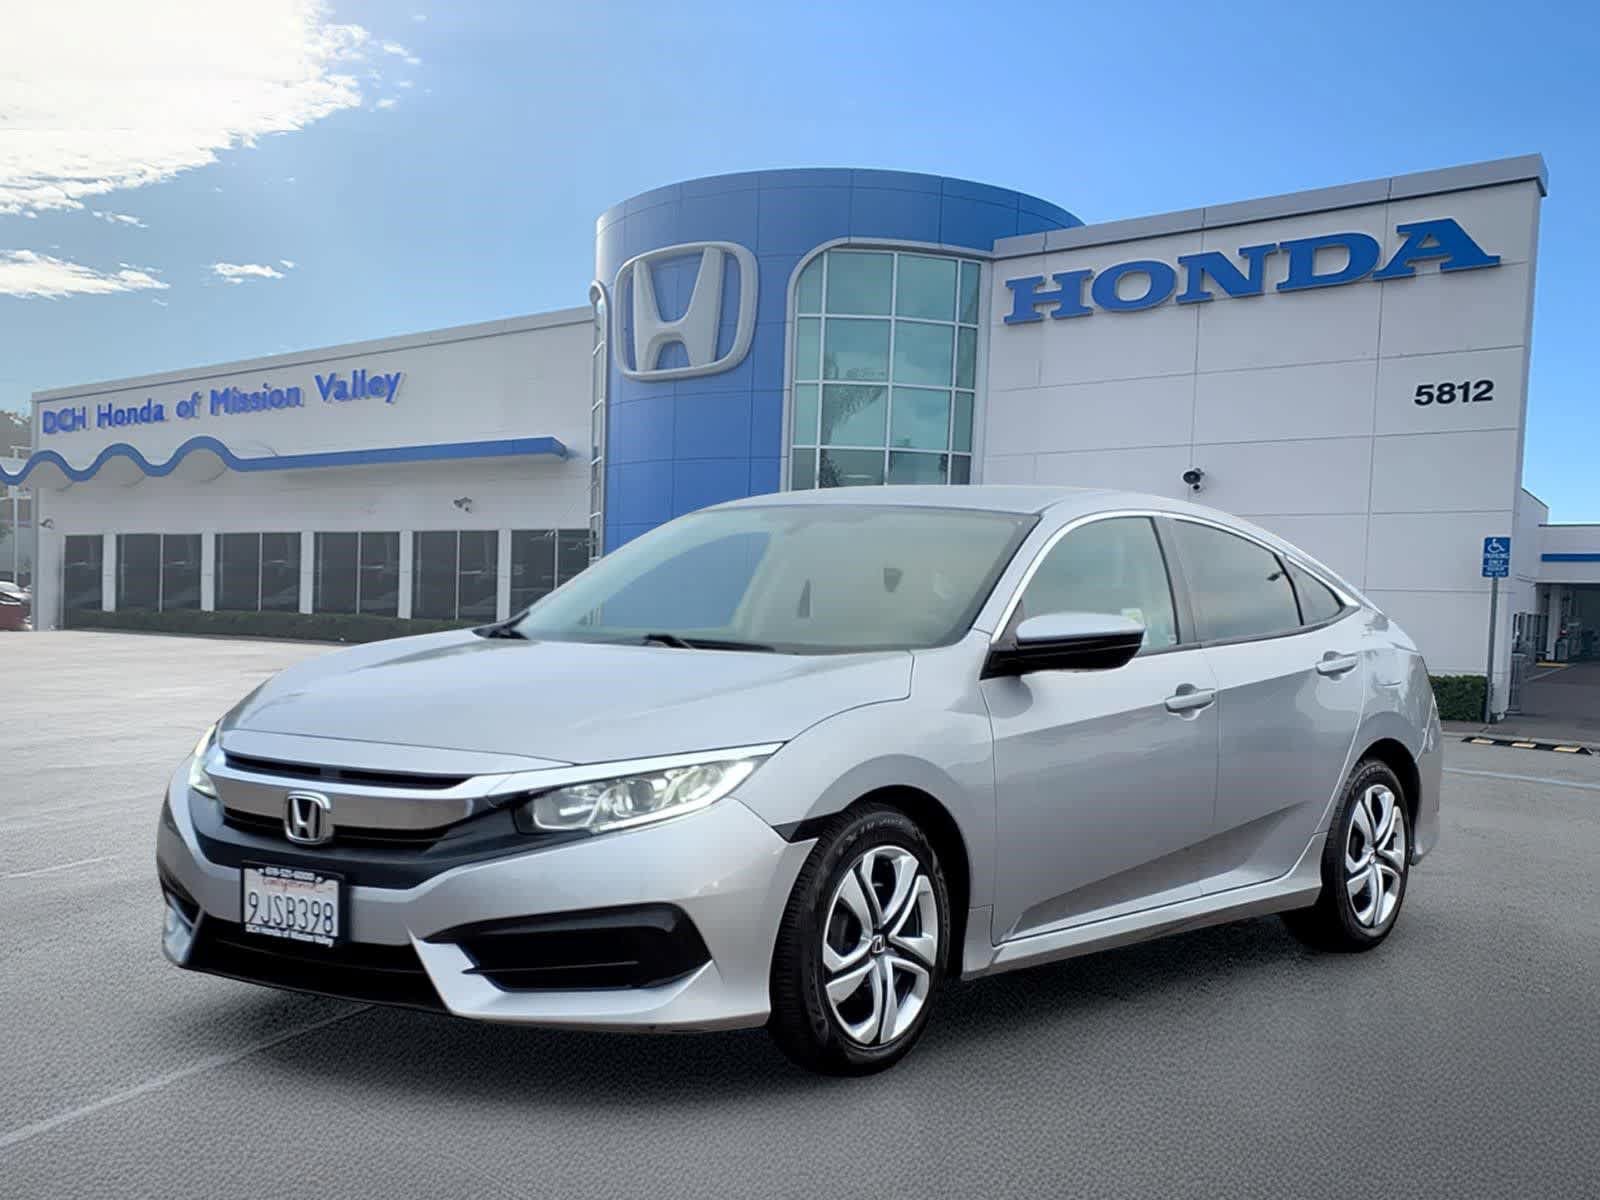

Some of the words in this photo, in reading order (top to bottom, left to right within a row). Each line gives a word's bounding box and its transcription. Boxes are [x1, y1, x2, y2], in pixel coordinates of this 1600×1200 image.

[1003, 217, 1501, 326] HONDA
[43, 407, 87, 434] DCH
[97, 398, 165, 428] Honda
[176, 393, 201, 419] of
[210, 383, 301, 415] Mission
[315, 370, 402, 403] Valley
[1414, 379, 1495, 406] 5812
[248, 891, 334, 934] 9JSB398
